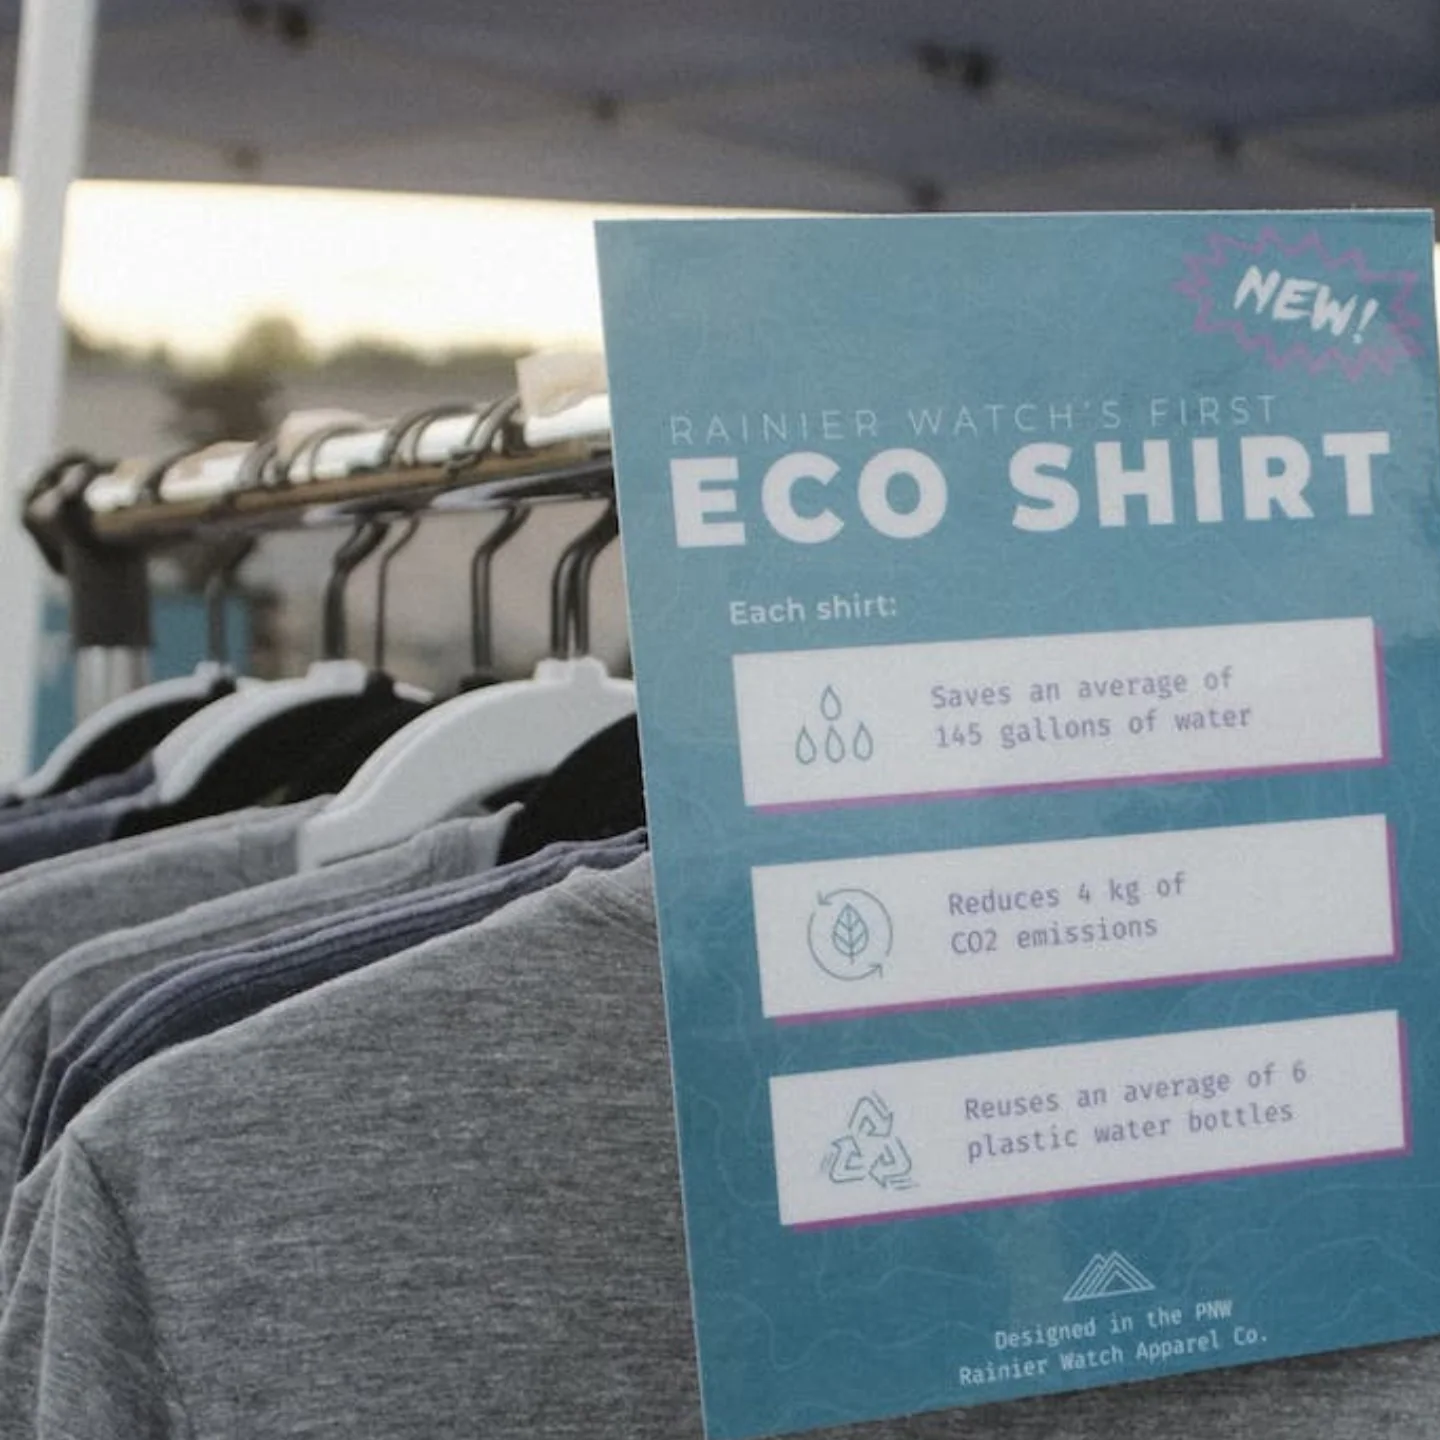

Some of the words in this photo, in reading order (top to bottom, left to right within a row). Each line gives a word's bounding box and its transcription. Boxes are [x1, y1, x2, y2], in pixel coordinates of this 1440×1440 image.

[1233, 265, 1379, 344] NEW!
[670, 411, 878, 445] RAINIER
[908, 400, 1121, 436] WATCH'S
[1148, 395, 1278, 427] FIRST
[670, 448, 948, 548] ECO
[1009, 432, 1391, 532] SHIRT
[730, 598, 806, 626] Each
[815, 595, 898, 622] shirt:
[930, 681, 1012, 711] Saves
[1029, 678, 1062, 704] an
[1076, 672, 1189, 706] average
[1203, 666, 1234, 694] of
[936, 721, 984, 749] 145
[1000, 714, 1113, 751] gallons
[1128, 708, 1158, 736] of
[1175, 705, 1252, 732] water
[948, 885, 1061, 916] Reduces
[1077, 882, 1091, 906] 4
[1109, 877, 1141, 907] kg
[1157, 873, 1187, 899] of
[951, 929, 998, 956] CO2
[1016, 916, 1158, 949] emissions
[964, 1091, 1061, 1121] Reuses
[1077, 1084, 1108, 1107] an
[1123, 1073, 1231, 1104] average
[1246, 1064, 1277, 1090] of
[1292, 1061, 1307, 1084] 6
[966, 1125, 1078, 1164] plastic
[1094, 1116, 1171, 1146] water
[1189, 1102, 1294, 1134] bottles
[994, 1319, 1096, 1351] Designed
[1109, 1313, 1134, 1336] in
[1146, 1305, 1184, 1328] the
[1195, 1299, 1233, 1322] PNW
[959, 1358, 1048, 1386] Rainier
[1061, 1345, 1123, 1373] Watch
[1135, 1332, 1222, 1363] Apparel
[1232, 1326, 1267, 1348] Co.
